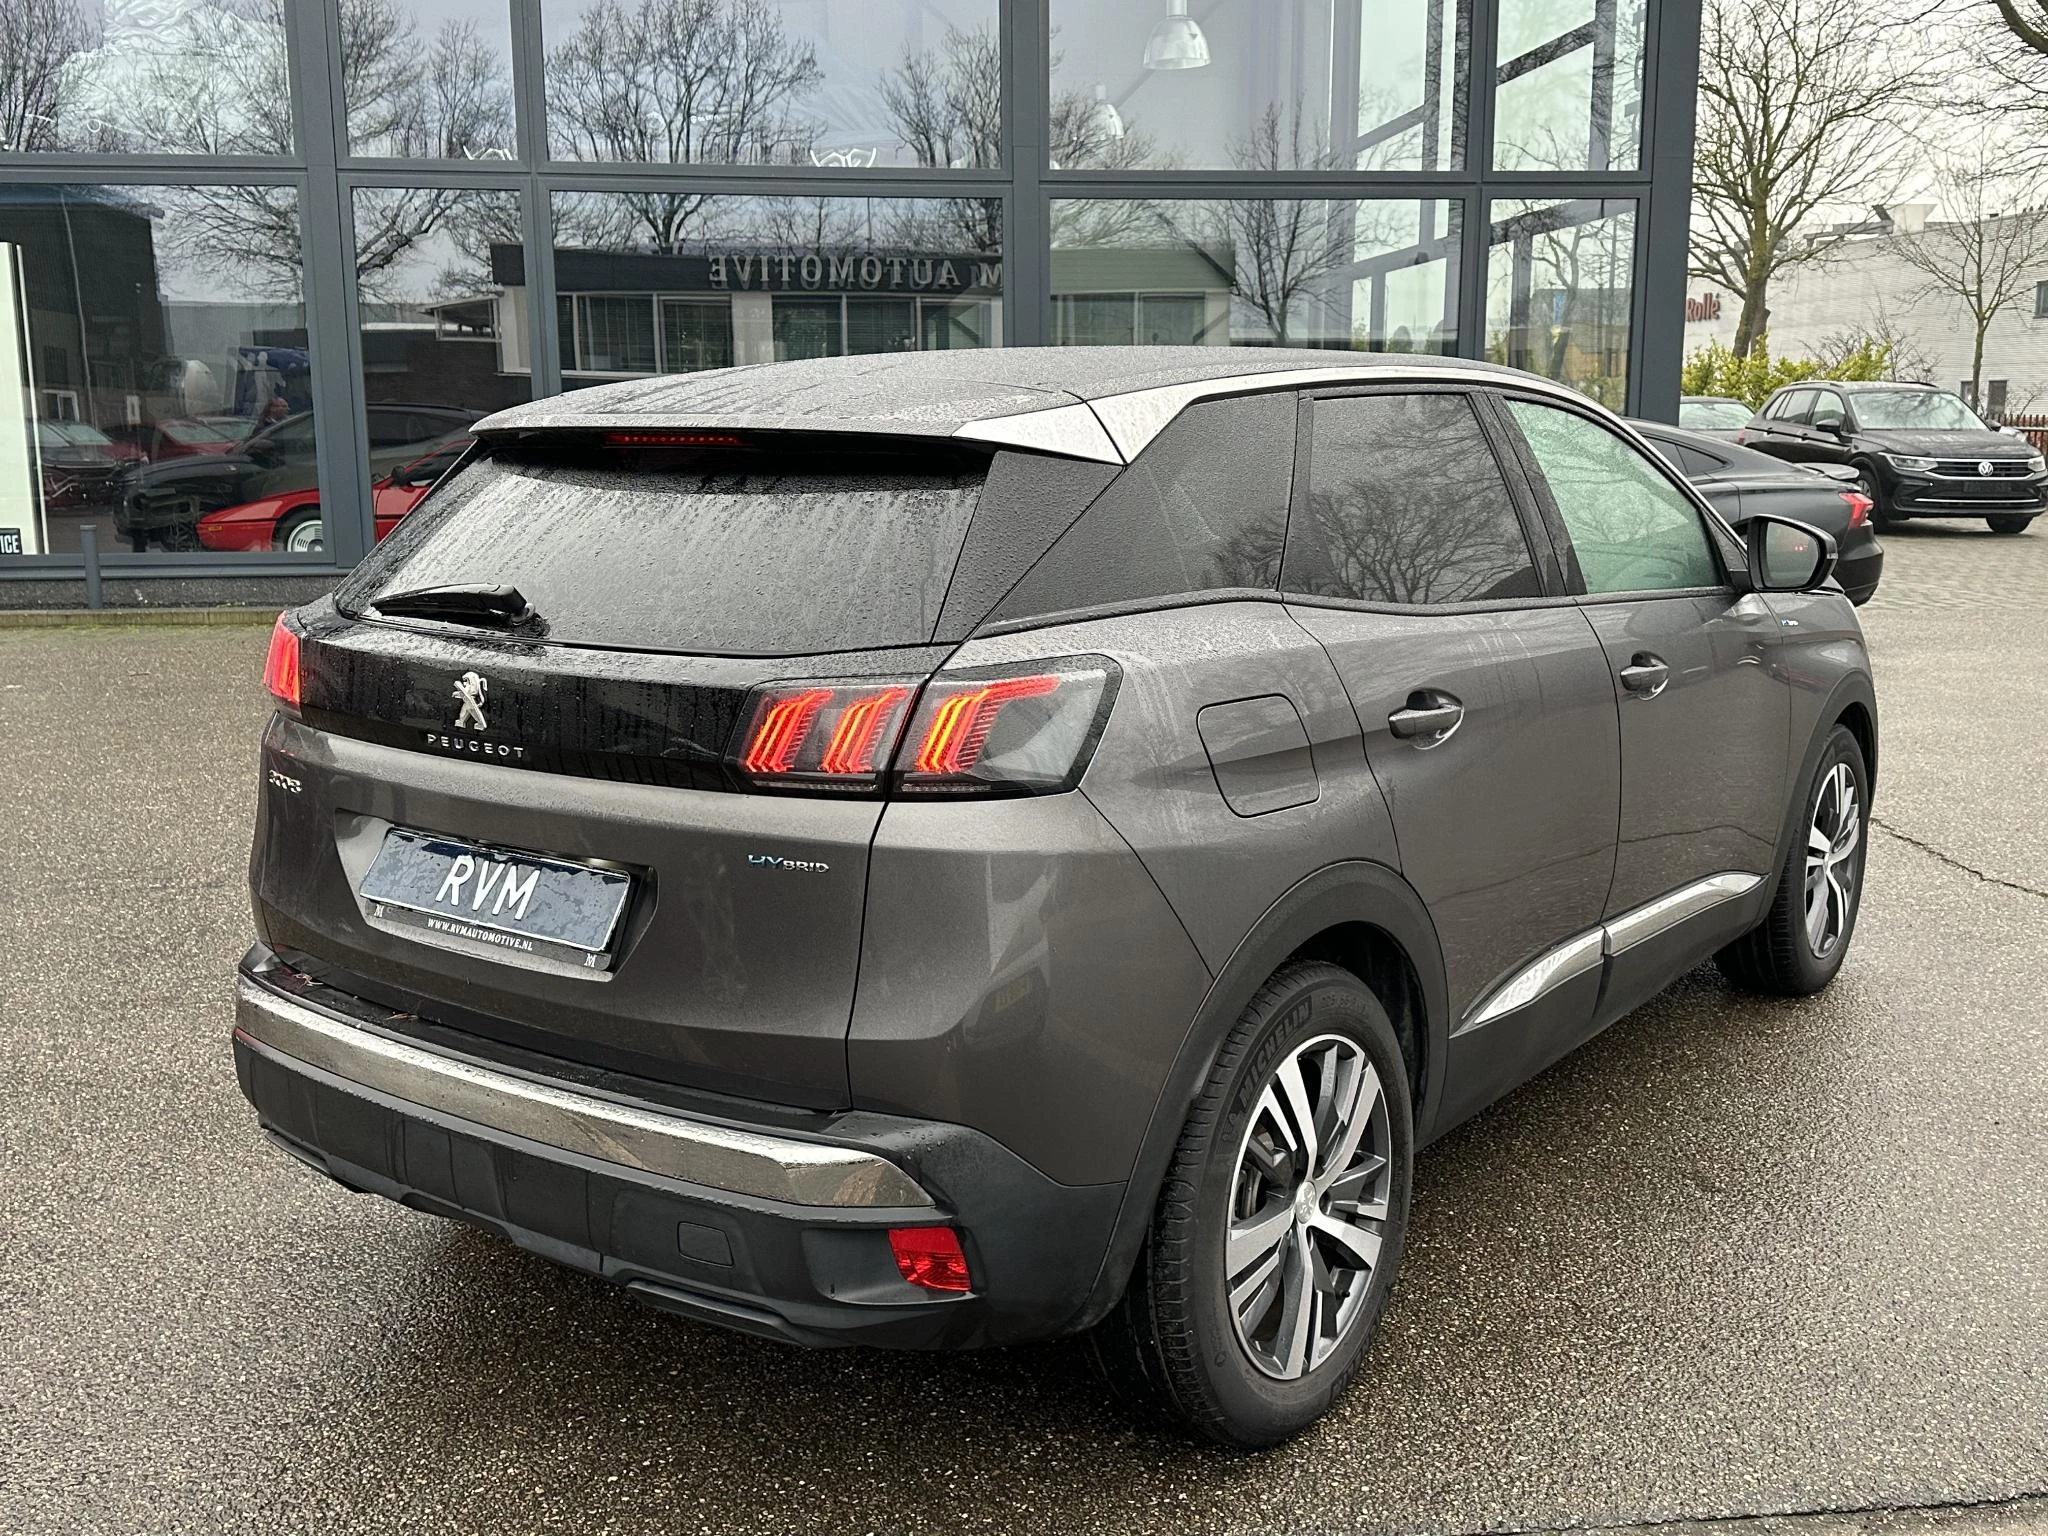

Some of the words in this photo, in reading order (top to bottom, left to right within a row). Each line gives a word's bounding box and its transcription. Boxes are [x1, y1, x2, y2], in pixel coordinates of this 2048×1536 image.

[0, 535, 20, 554] ICE
[426, 733, 524, 758] PEUGEOT
[747, 854, 830, 873] HYBRID
[435, 854, 541, 921] RVM
[427, 918, 533, 951] WWW.RVMAUTOMOTIVE.NL
[1239, 1001, 1311, 1110] MICHELIN
